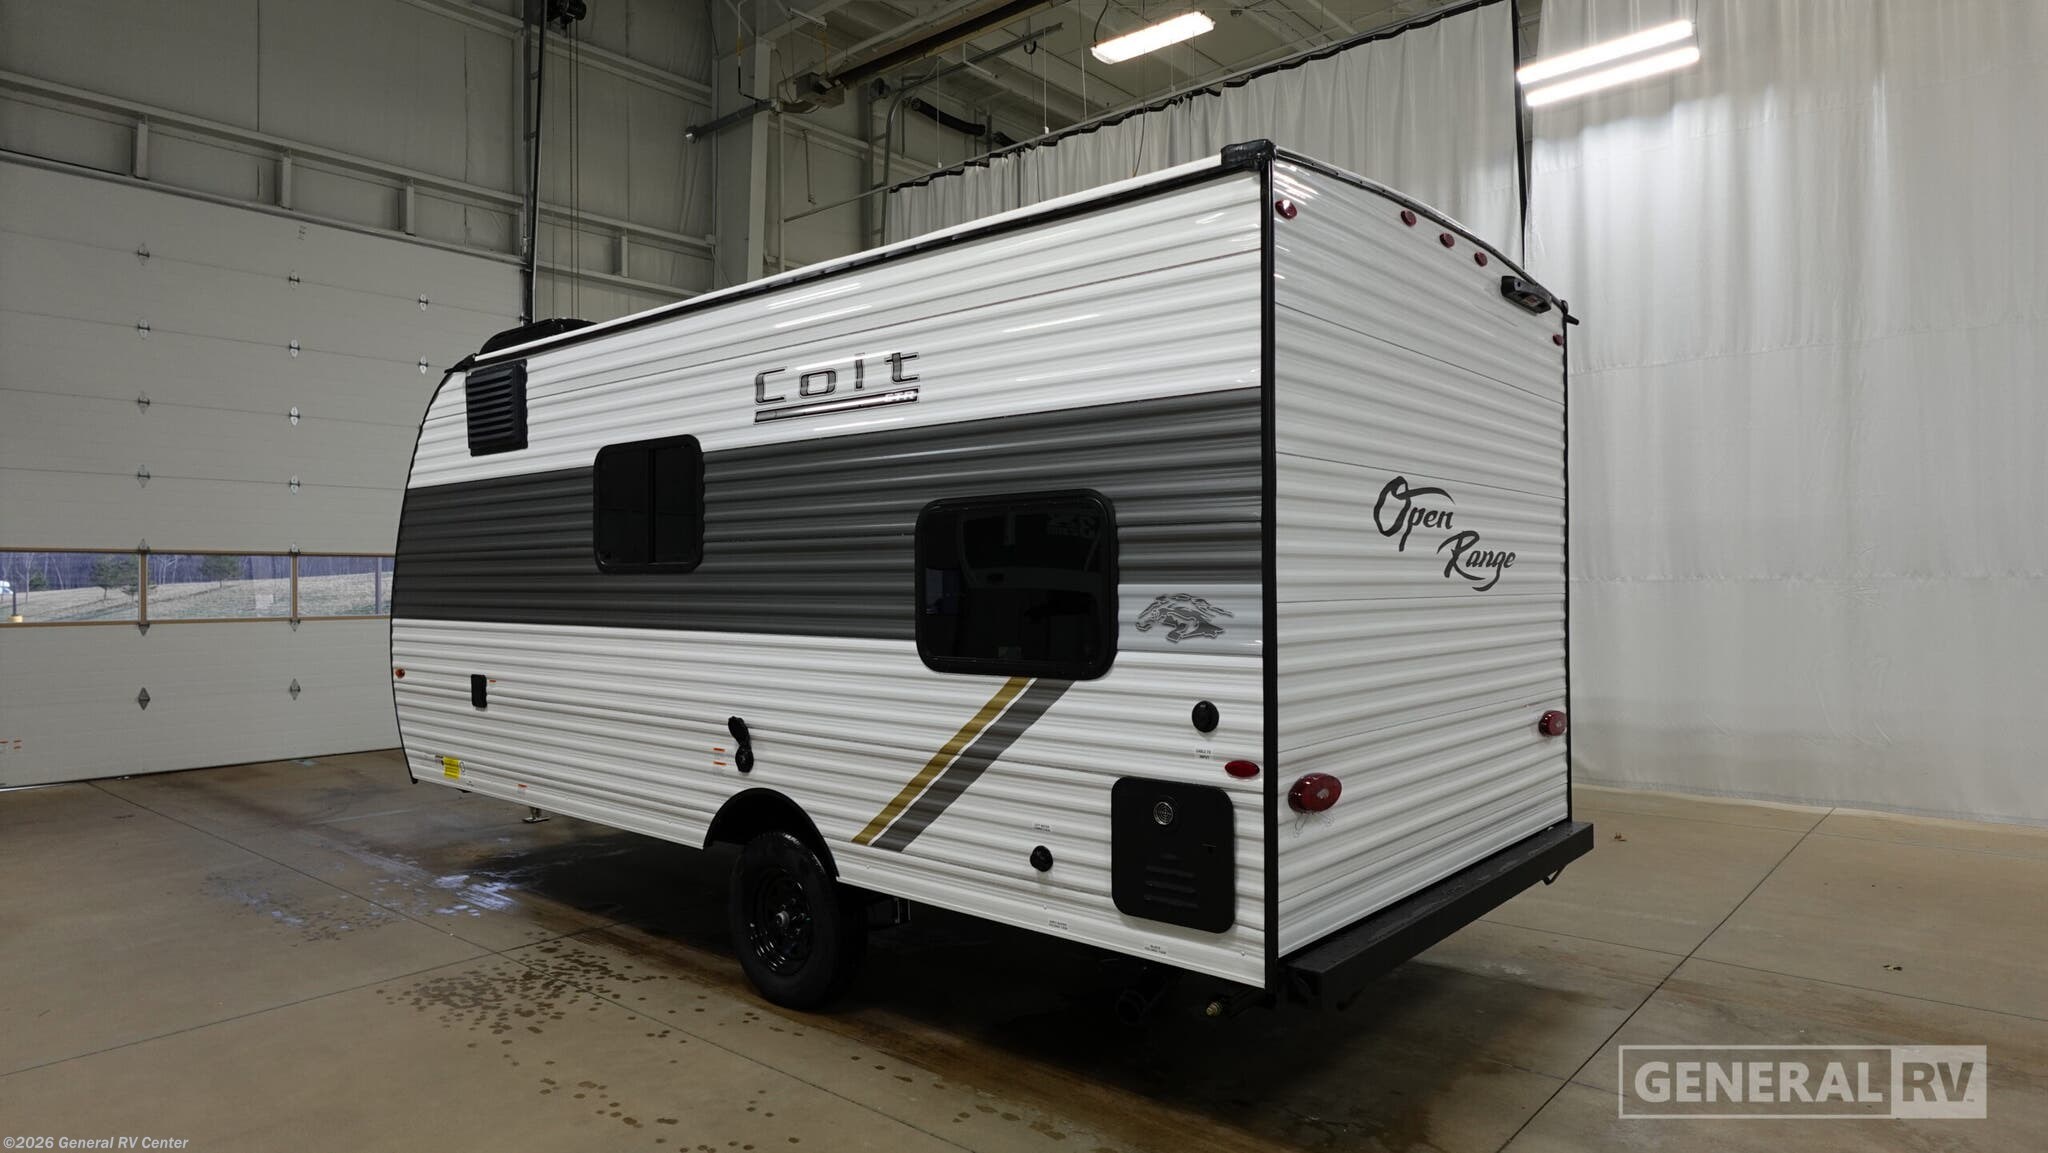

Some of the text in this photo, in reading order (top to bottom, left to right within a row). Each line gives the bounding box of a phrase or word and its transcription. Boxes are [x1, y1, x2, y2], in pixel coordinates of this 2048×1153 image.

[755, 352, 920, 404] Colt
[1373, 475, 1456, 552] Open
[1436, 530, 1516, 592] Range
